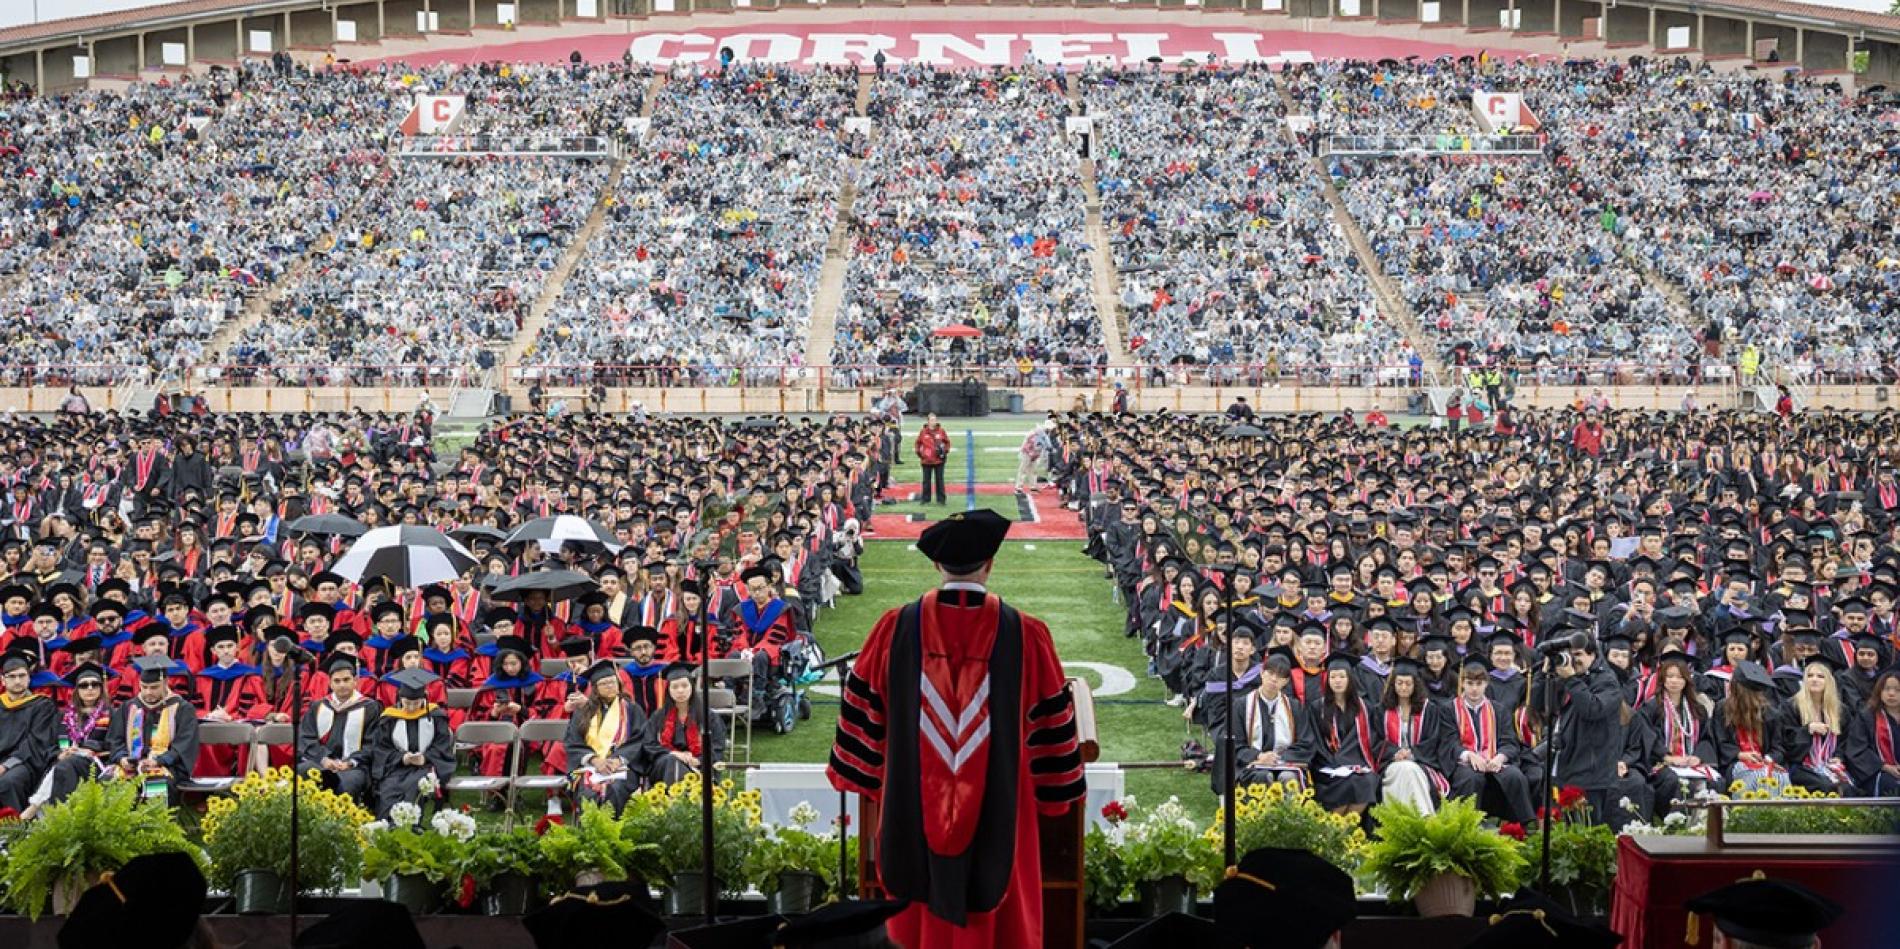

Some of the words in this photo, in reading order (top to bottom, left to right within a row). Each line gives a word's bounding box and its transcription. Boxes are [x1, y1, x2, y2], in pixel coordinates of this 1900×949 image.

[630, 32, 1315, 66] CORNELL
[433, 99, 449, 122] C
[1488, 96, 1505, 115] C
